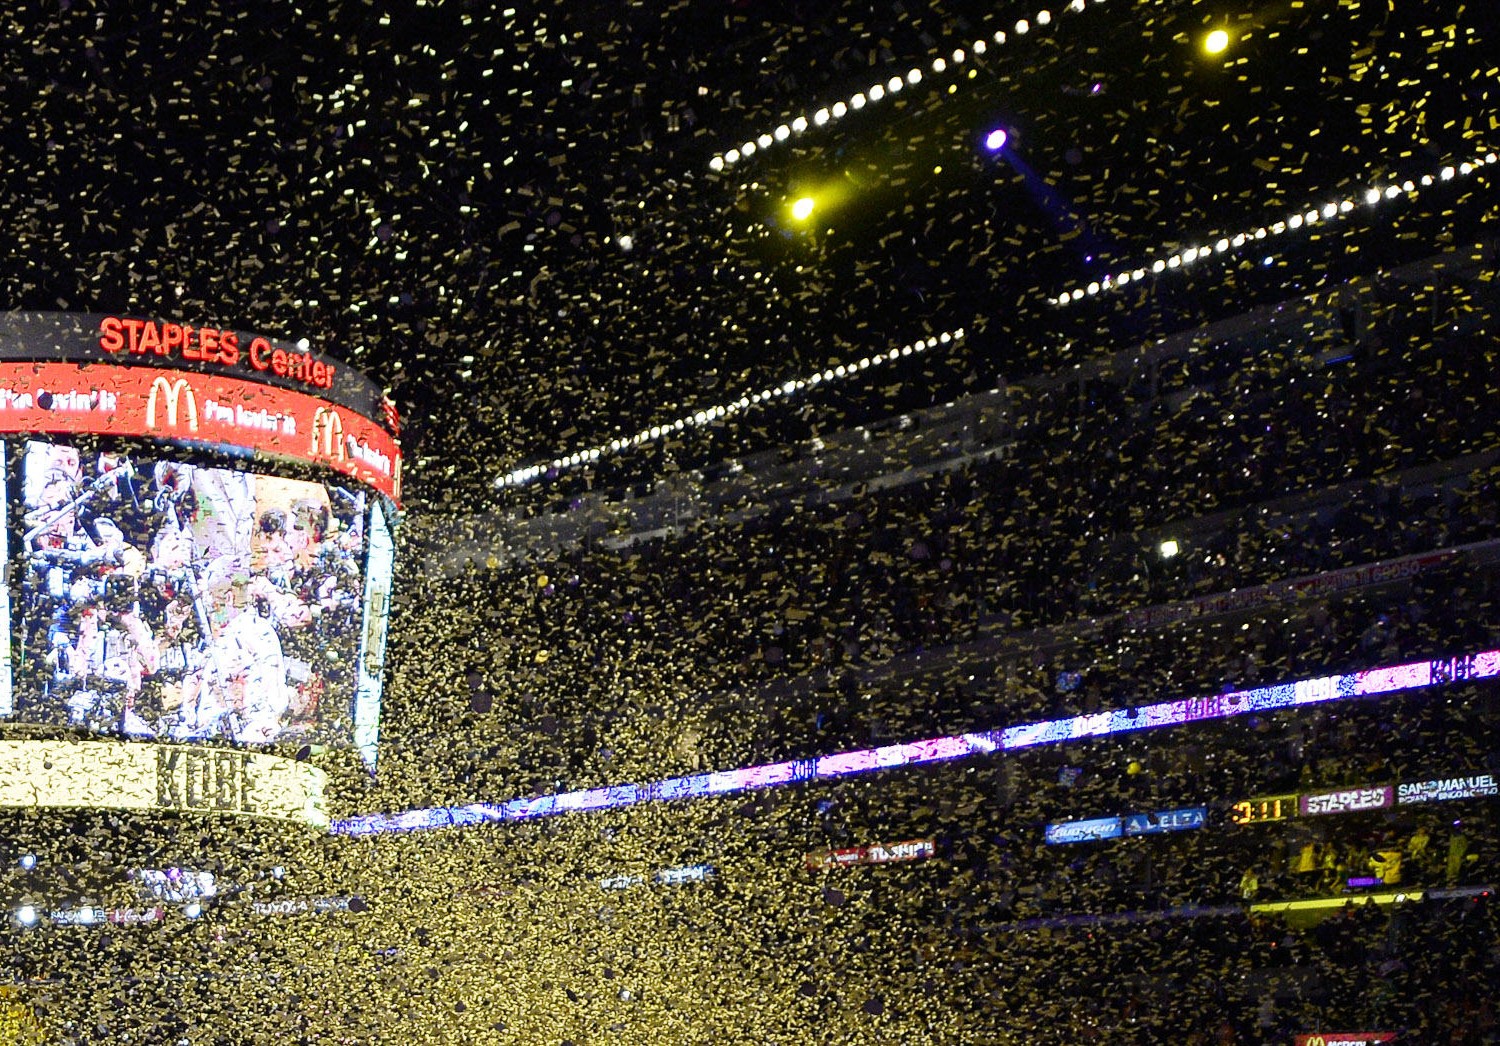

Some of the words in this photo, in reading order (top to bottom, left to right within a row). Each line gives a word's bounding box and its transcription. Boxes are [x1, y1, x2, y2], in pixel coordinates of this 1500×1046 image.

[100, 317, 239, 365] STAPLES
[250, 337, 336, 388] Center
[37, 388, 97, 410] lvin'
[1295, 675, 1342, 705] KOBE
[156, 747, 257, 813] KOBE
[1399, 783, 1425, 797] SAN
[1438, 775, 1498, 792] MANUEL
[1308, 788, 1386, 814] STAPLES
[1147, 812, 1205, 829] DELTA
